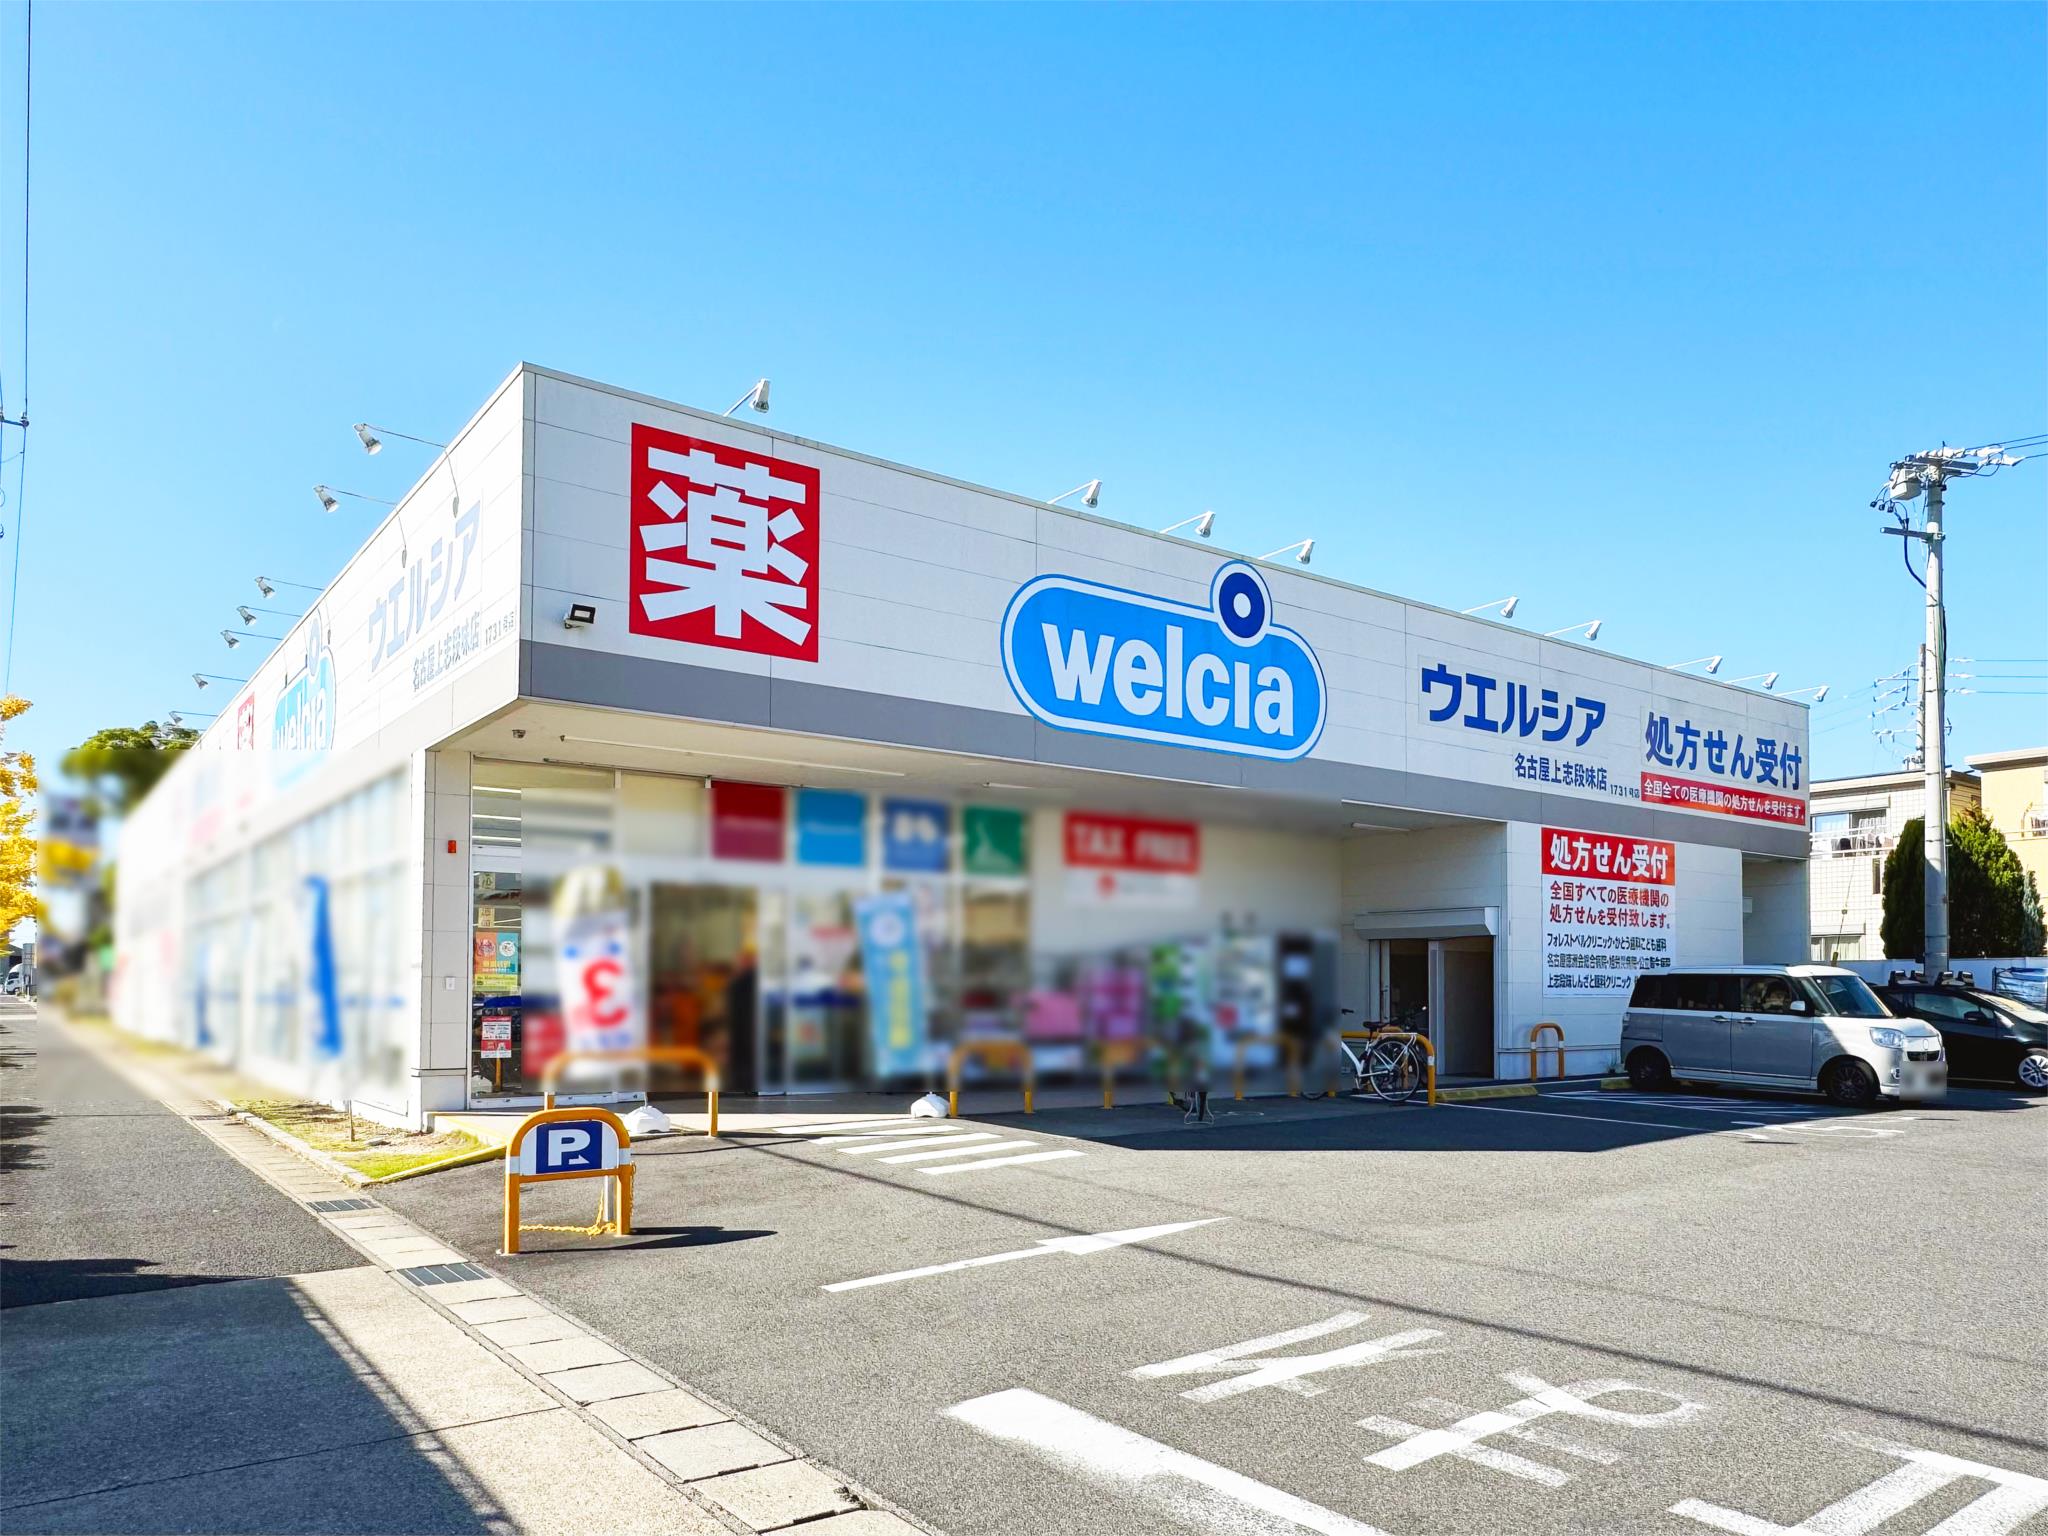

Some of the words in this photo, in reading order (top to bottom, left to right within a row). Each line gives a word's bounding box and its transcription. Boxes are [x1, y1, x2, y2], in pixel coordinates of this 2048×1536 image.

[638, 445, 812, 647] 薬
[368, 500, 481, 673] ウエルシア
[1040, 622, 1295, 738] welcia
[1421, 663, 1606, 747] ウエルシア
[1514, 752, 1608, 791] 名古屋上志段味店
[1645, 711, 1802, 791] 処方せん受付
[1550, 833, 1669, 881] 処方せん受付
[1549, 903, 1671, 930] 処方せんを受付致します。
[1550, 880, 1669, 908] 全国すべての医療機関の
[547, 1128, 591, 1167] P
